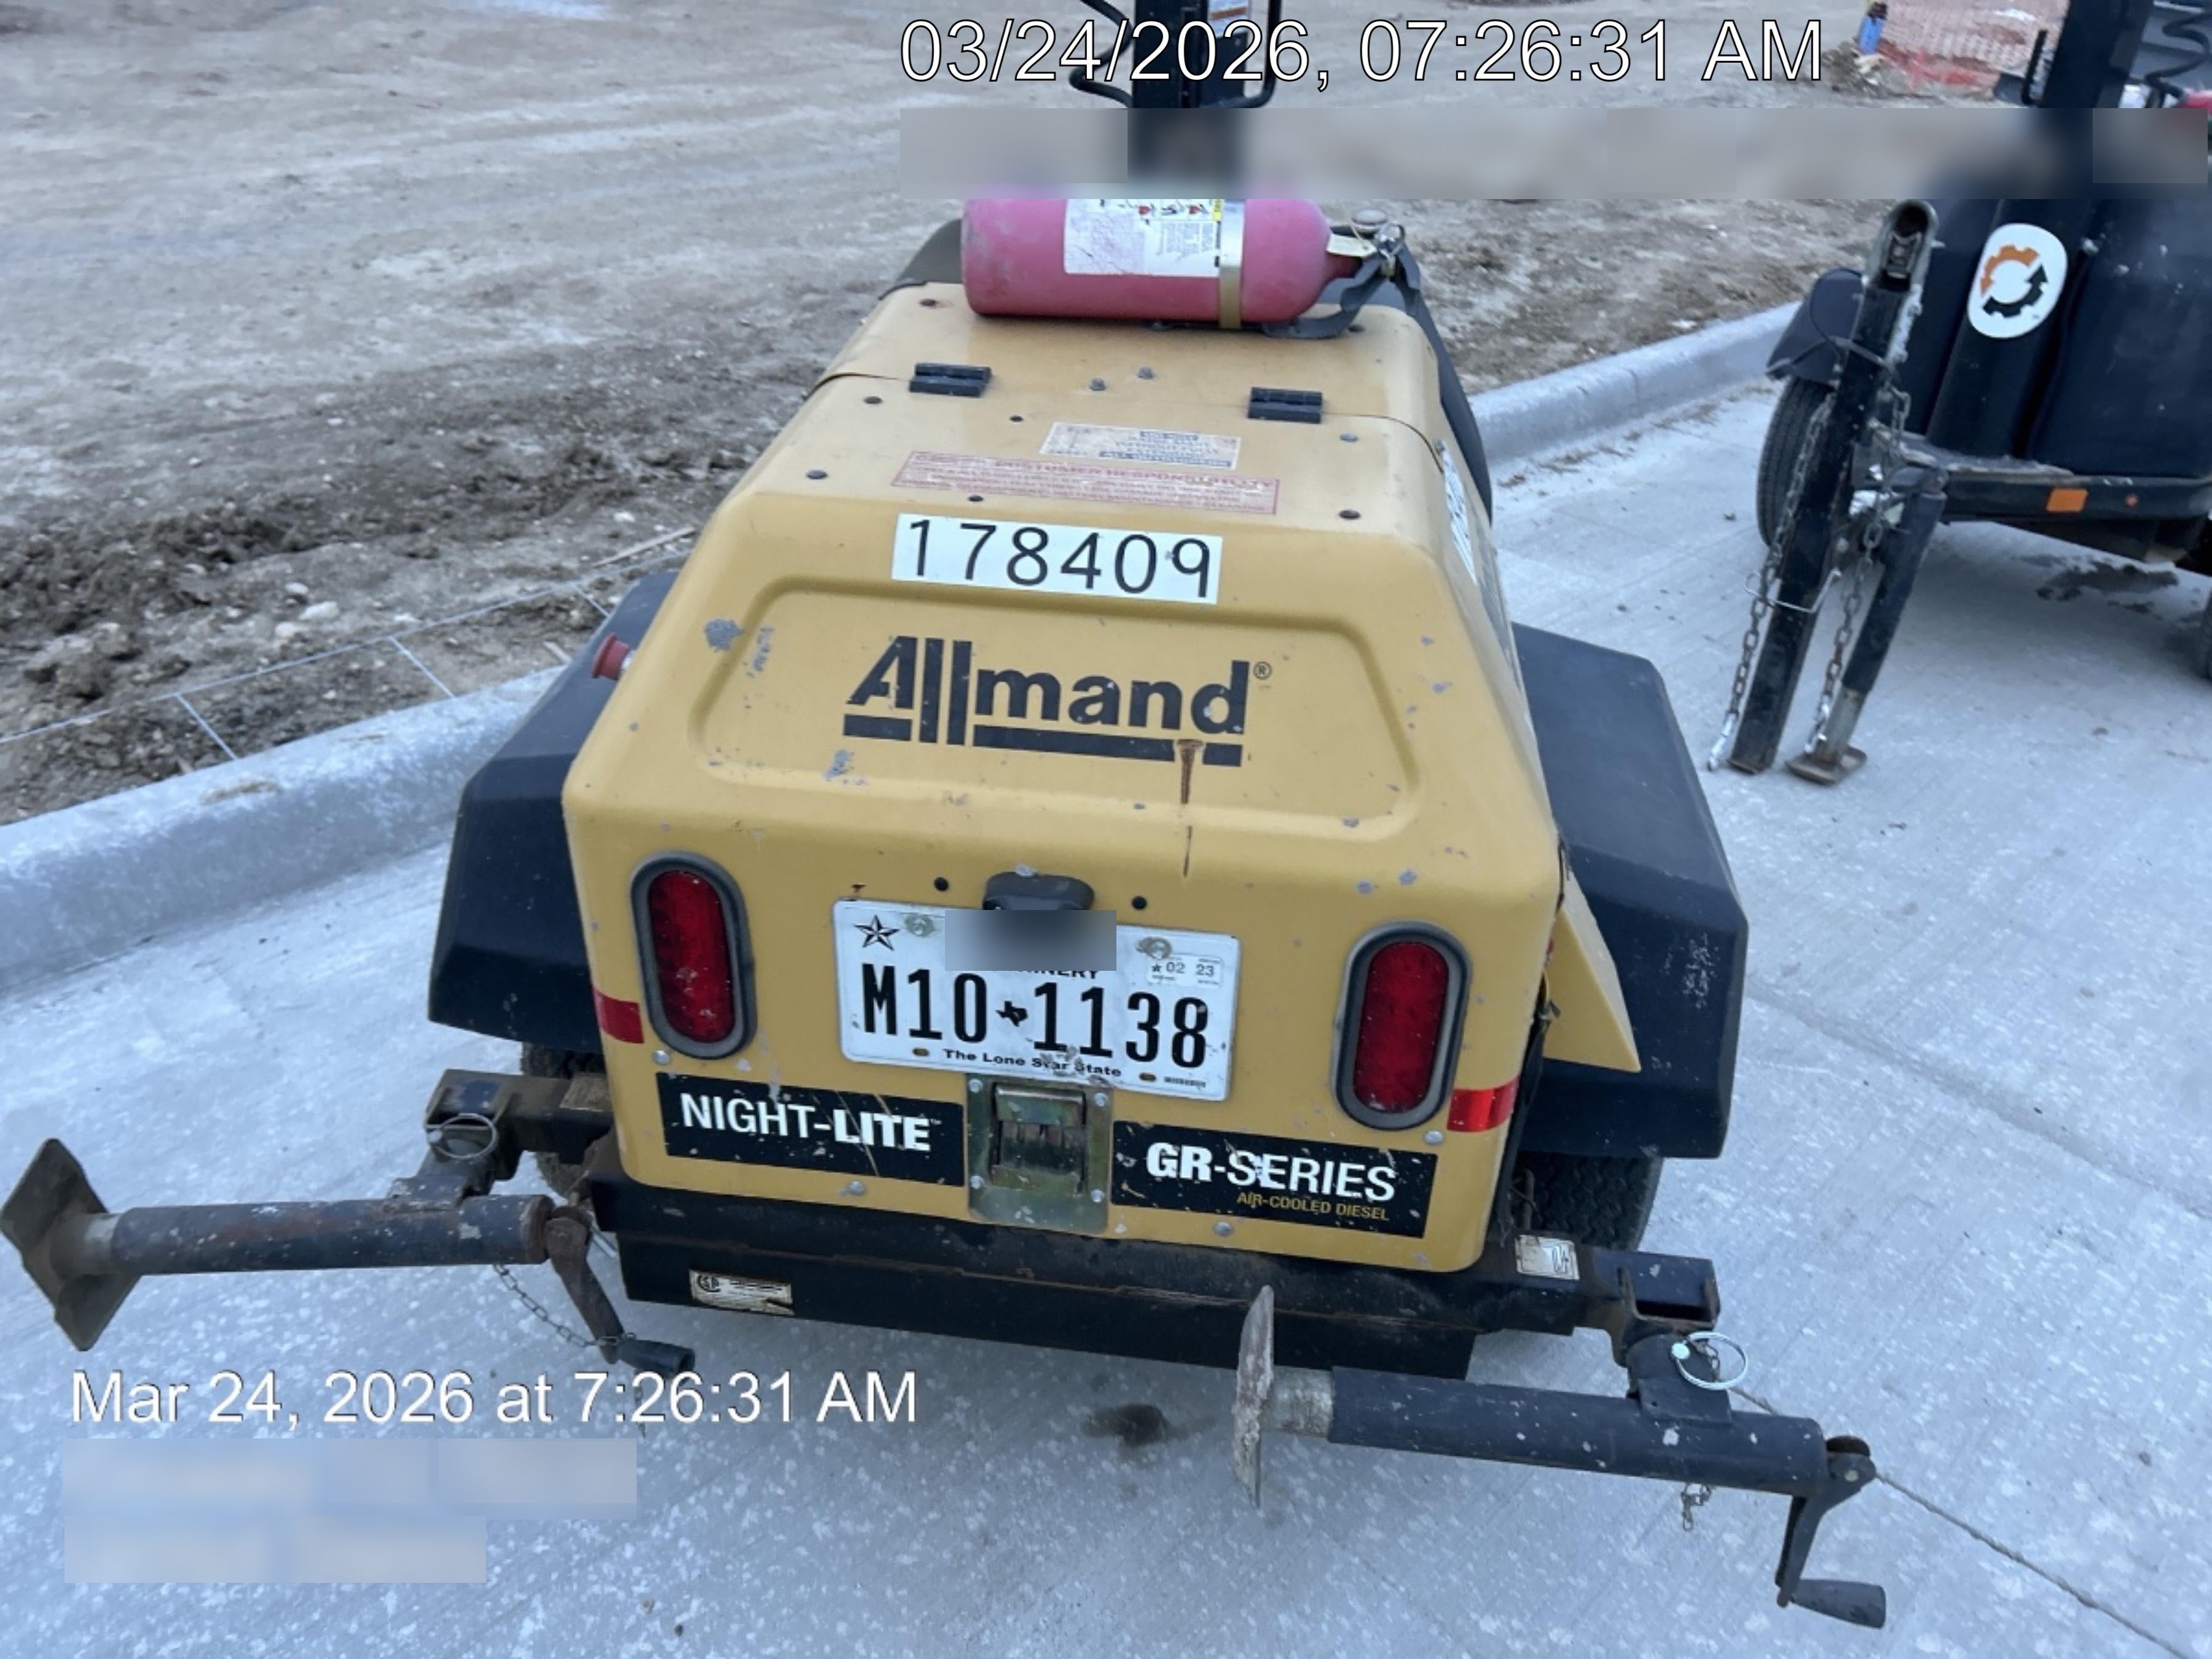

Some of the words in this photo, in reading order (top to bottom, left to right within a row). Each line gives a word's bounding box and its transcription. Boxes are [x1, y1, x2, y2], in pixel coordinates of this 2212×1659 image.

[910, 519, 1210, 598] 178409
[1166, 962, 1185, 974] 02
[1196, 964, 1214, 977] 23
[861, 963, 987, 1043] M10
[1033, 981, 1209, 1069] 1138
[943, 1049, 977, 1061] The
[983, 1053, 1026, 1066] Lone
[1032, 1058, 1069, 1071] Star
[1075, 1062, 1122, 1077] State
[680, 1092, 931, 1152] NIGHT-LITE
[1146, 1141, 1397, 1202] GR-SERIES
[1237, 1191, 1332, 1214] AIR-COOLED
[1336, 1202, 1390, 1222] DIESEL
